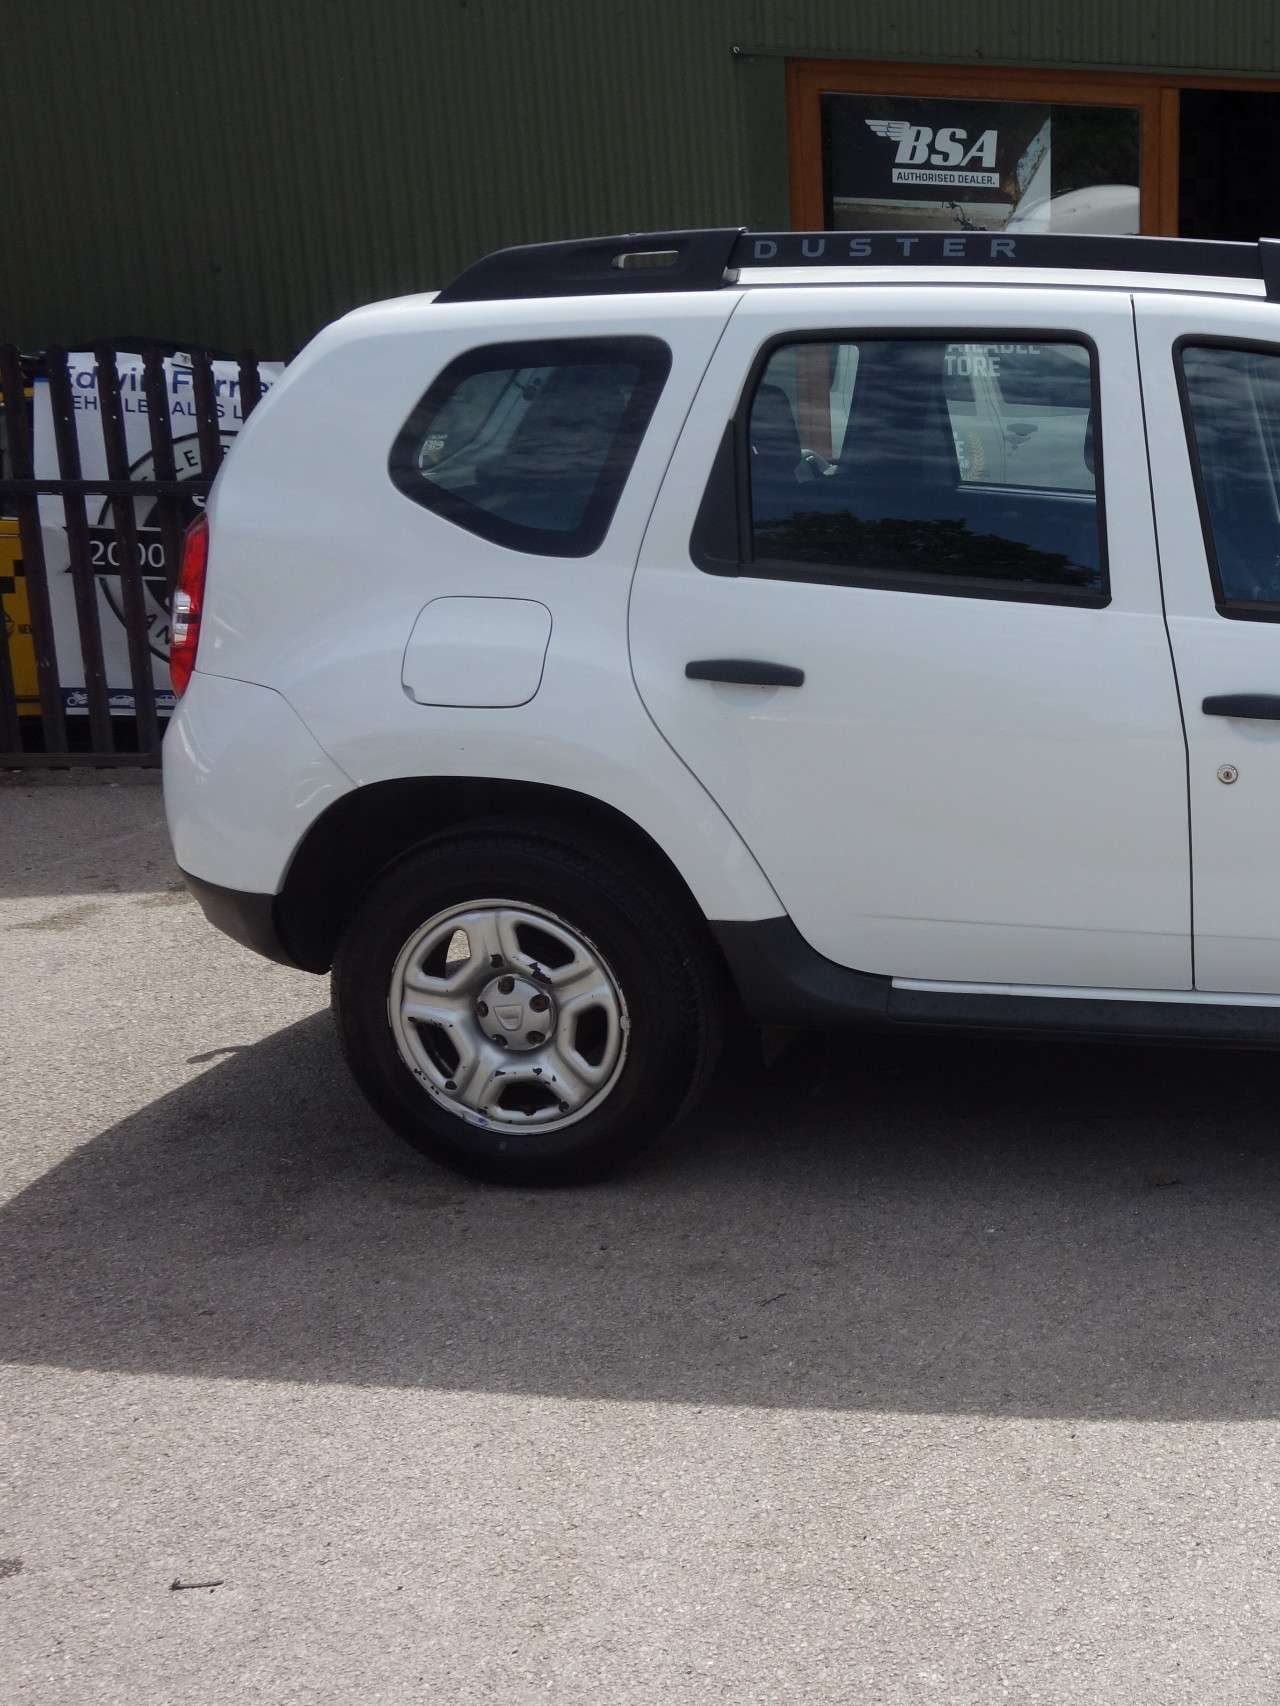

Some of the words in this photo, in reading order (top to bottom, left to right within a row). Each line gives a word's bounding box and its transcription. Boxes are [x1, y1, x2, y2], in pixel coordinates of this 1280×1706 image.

[894, 125, 998, 168] BSA
[896, 171, 956, 183] AUTHORISED
[753, 238, 1017, 259] DUSTER
[72, 395, 149, 413] EHLE
[171, 401, 225, 418] ALS
